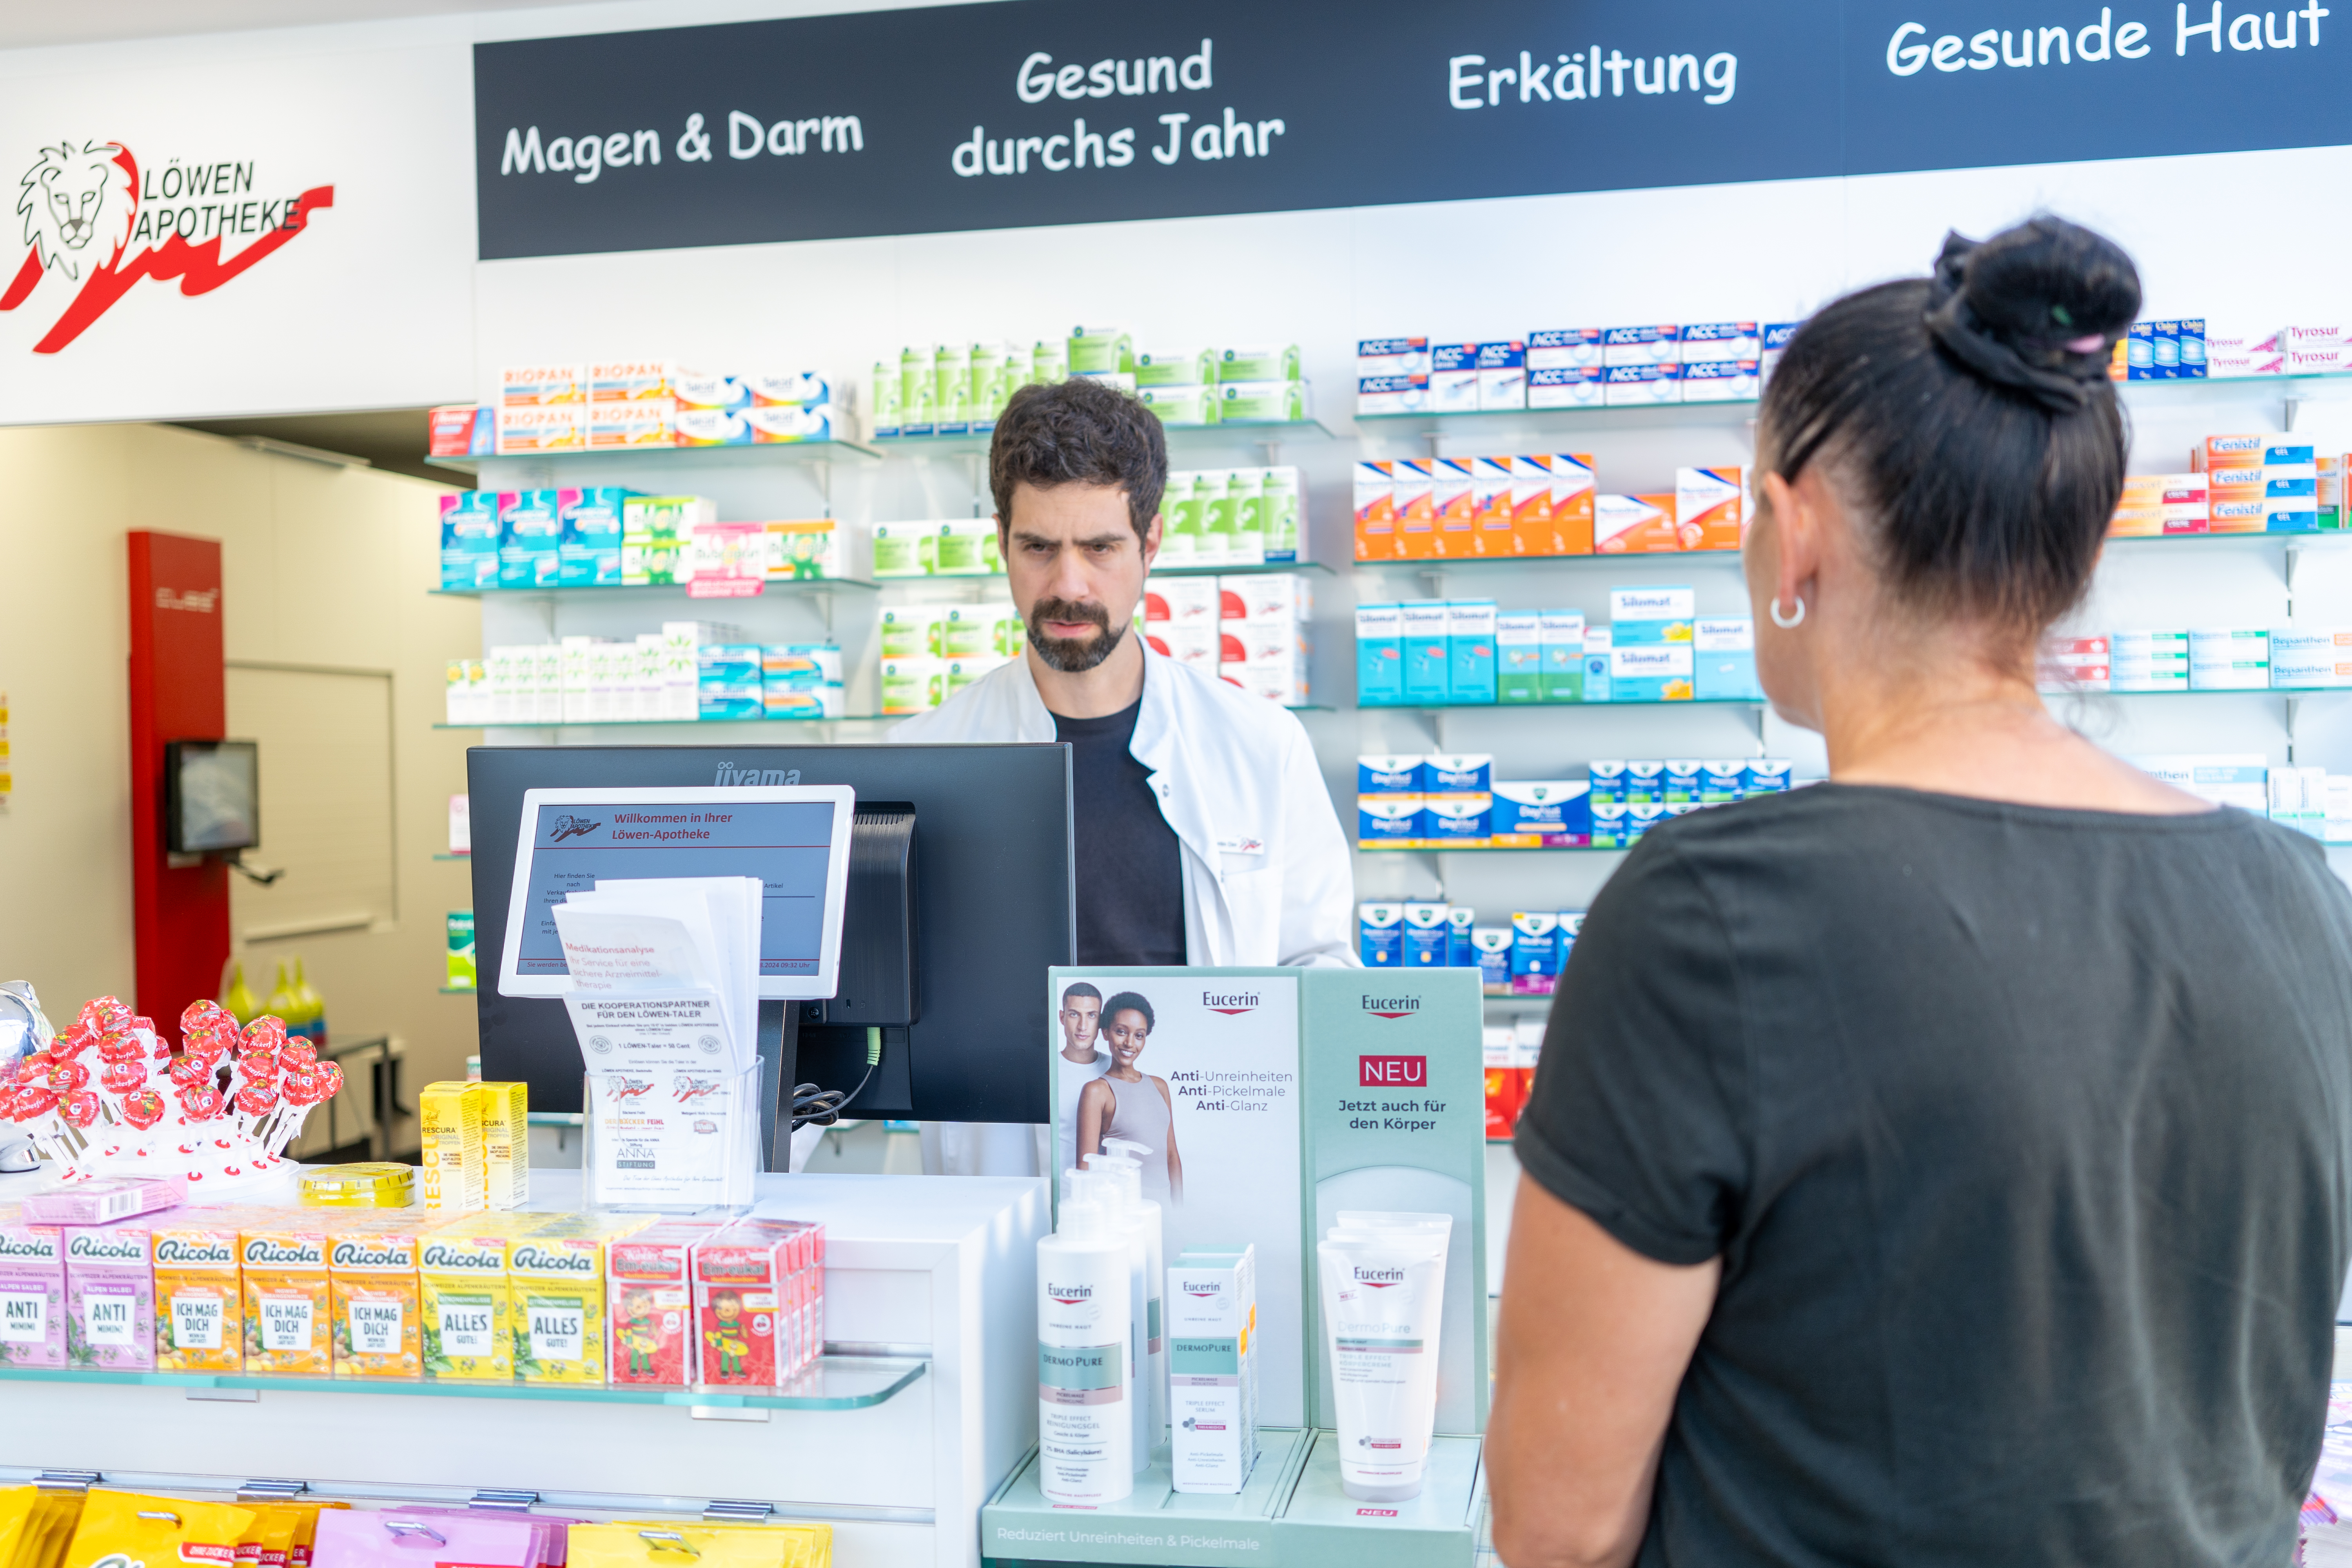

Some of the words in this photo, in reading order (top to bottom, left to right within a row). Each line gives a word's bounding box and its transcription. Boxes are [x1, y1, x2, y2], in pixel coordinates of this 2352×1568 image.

[1886, 6, 2151, 76] Gesunde
[2176, 0, 2330, 57] Haut
[1016, 38, 1212, 103] Gesund
[1449, 44, 1738, 110] Erkältung
[501, 125, 662, 184] Magen
[676, 113, 712, 162] &
[729, 109, 863, 160] Darm
[951, 118, 1135, 177] durchs
[1151, 107, 1285, 165] Jahr
[143, 158, 254, 200] LÖWEN
[133, 198, 303, 242] APOTHEKE
[2214, 437, 2261, 450] Fenistil
[2216, 470, 2262, 483] Fenistil
[2217, 503, 2263, 516] Fenistil
[714, 762, 801, 786] iiyama
[614, 813, 687, 823] Willkommen
[690, 813, 701, 822] in
[704, 813, 732, 822] Ihrer
[612, 829, 710, 841] Löwen-Apotheke
[566, 942, 654, 955] Medikationsanalyse
[570, 956, 579, 965] Ihr
[582, 957, 613, 967] Service
[615, 958, 627, 967] für
[573, 969, 603, 978] sichere
[605, 970, 662, 979] Arzneimittel-
[576, 980, 612, 990] therapie
[599, 1000, 710, 1009] KOOPERATIONSPARTNER
[1202, 992, 1259, 1007] Eucerin
[1361, 995, 1419, 1010] Eucerin
[597, 1010, 615, 1018] FÜR
[637, 1009, 701, 1018] LÖWEN-TALER
[1170, 1070, 1292, 1083] Anti-Unreinheiten
[1365, 1061, 1421, 1082] NEU
[1178, 1085, 1285, 1098] Anti-Pickelmale
[1196, 1099, 1267, 1113] Anti-Glanz
[1338, 1100, 1377, 1113] Jetzt
[1381, 1100, 1419, 1112] auch
[1423, 1100, 1446, 1112] für
[1349, 1117, 1379, 1131] den
[1383, 1116, 1436, 1132] Körper
[617, 1148, 655, 1159] ANNA
[71, 1235, 142, 1258] Ricola
[158, 1240, 231, 1261] Ricola
[247, 1240, 321, 1262] Ricola
[334, 1243, 408, 1265] Ricola
[425, 1246, 500, 1268] Ricola
[515, 1247, 591, 1270] Ricola
[1354, 1266, 1404, 1281] Eucerin
[1048, 1283, 1092, 1298] Eucerin
[1183, 1281, 1220, 1292] Eucerin
[6, 1301, 38, 1319] ANTI
[93, 1304, 125, 1321] ANTI
[176, 1303, 192, 1316] ICH
[196, 1304, 218, 1317] MAG
[266, 1305, 282, 1318] ICH
[285, 1306, 308, 1319] MAG
[355, 1307, 371, 1320] ICH
[374, 1308, 397, 1321] MAG
[185, 1318, 209, 1331] DICH
[275, 1319, 298, 1333] DICH
[364, 1322, 388, 1336] DICH
[445, 1314, 487, 1332] ALLES
[534, 1316, 578, 1335] ALLES
[997, 1527, 1065, 1543] Reduziert
[1069, 1530, 1163, 1548] Unreinheiten
[1167, 1534, 1176, 1547] &
[1180, 1535, 1259, 1551] Pickelmale
